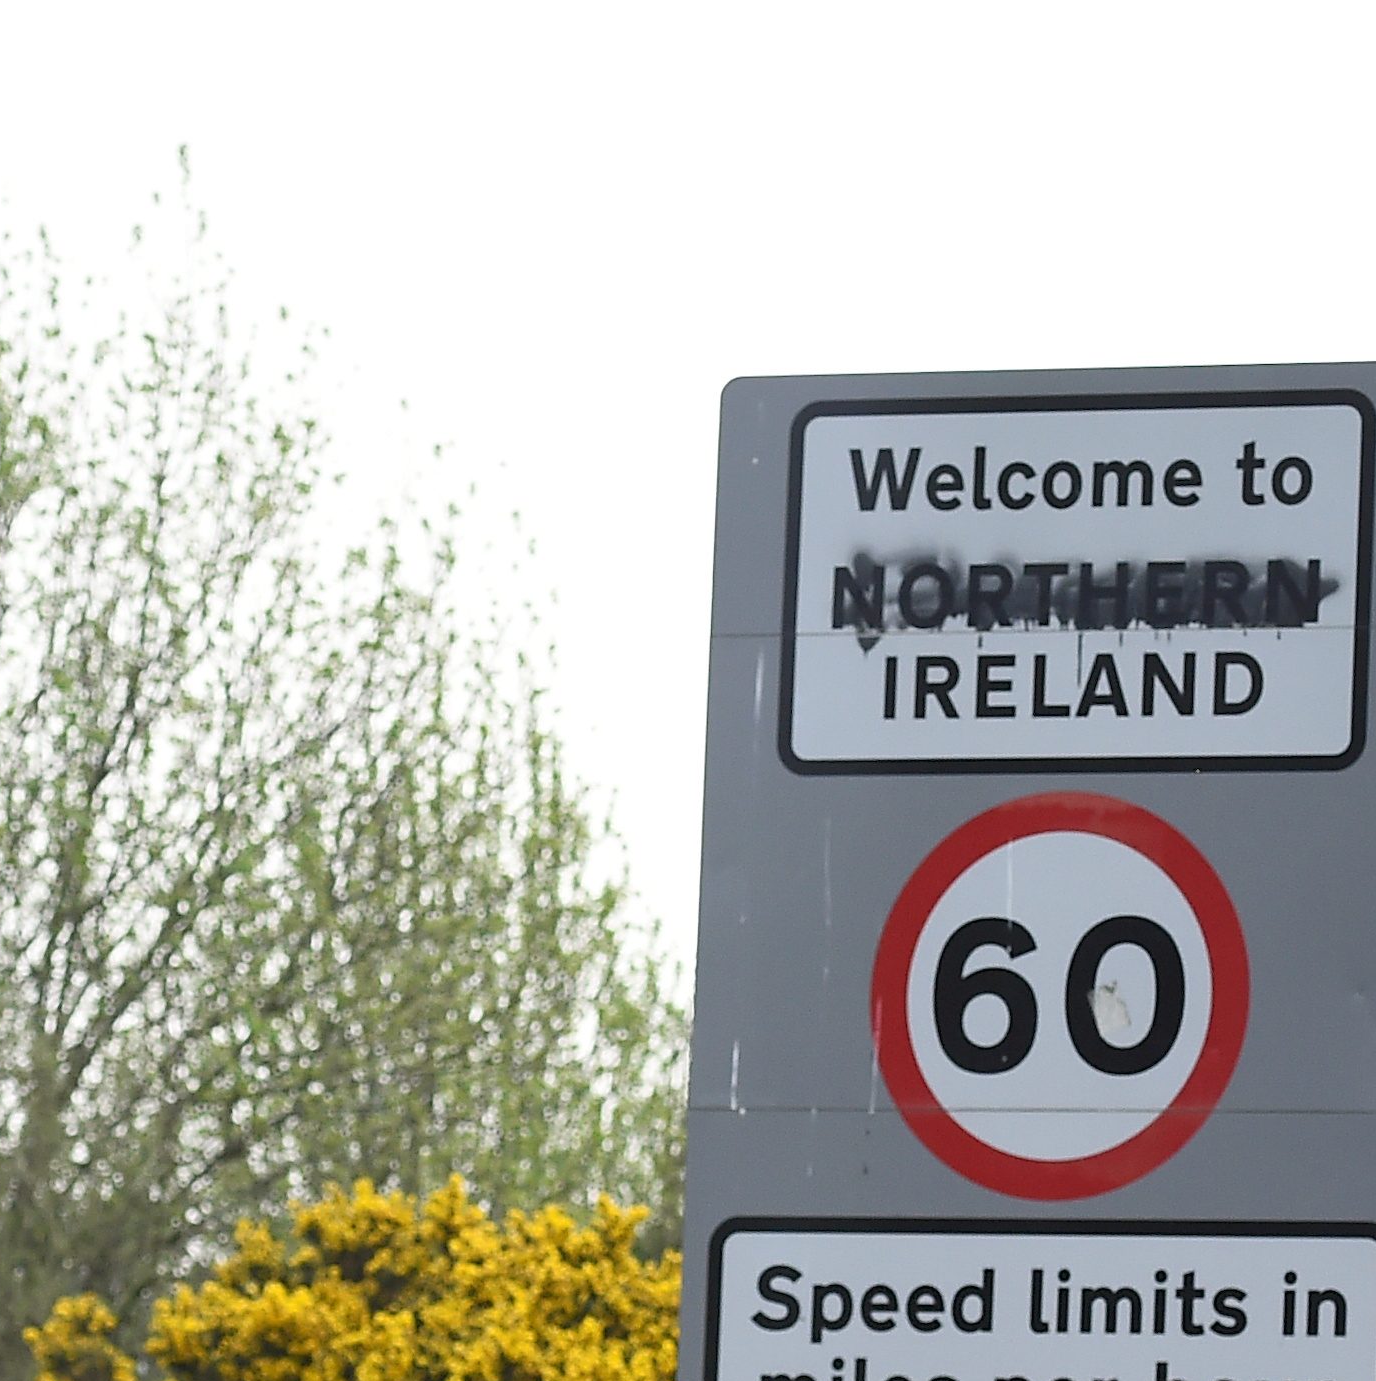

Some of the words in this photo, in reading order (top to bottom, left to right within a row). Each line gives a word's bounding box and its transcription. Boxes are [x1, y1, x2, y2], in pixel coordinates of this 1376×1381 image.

[850, 446, 1202, 511] Welcome
[1236, 441, 1313, 505] to
[832, 559, 1322, 629] NORTHERN
[883, 651, 1265, 720] IRELAND
[933, 914, 1186, 1075] 60
[751, 1265, 995, 1343] Speed
[1028, 1268, 1249, 1337] limits
[1281, 1272, 1348, 1337] in
